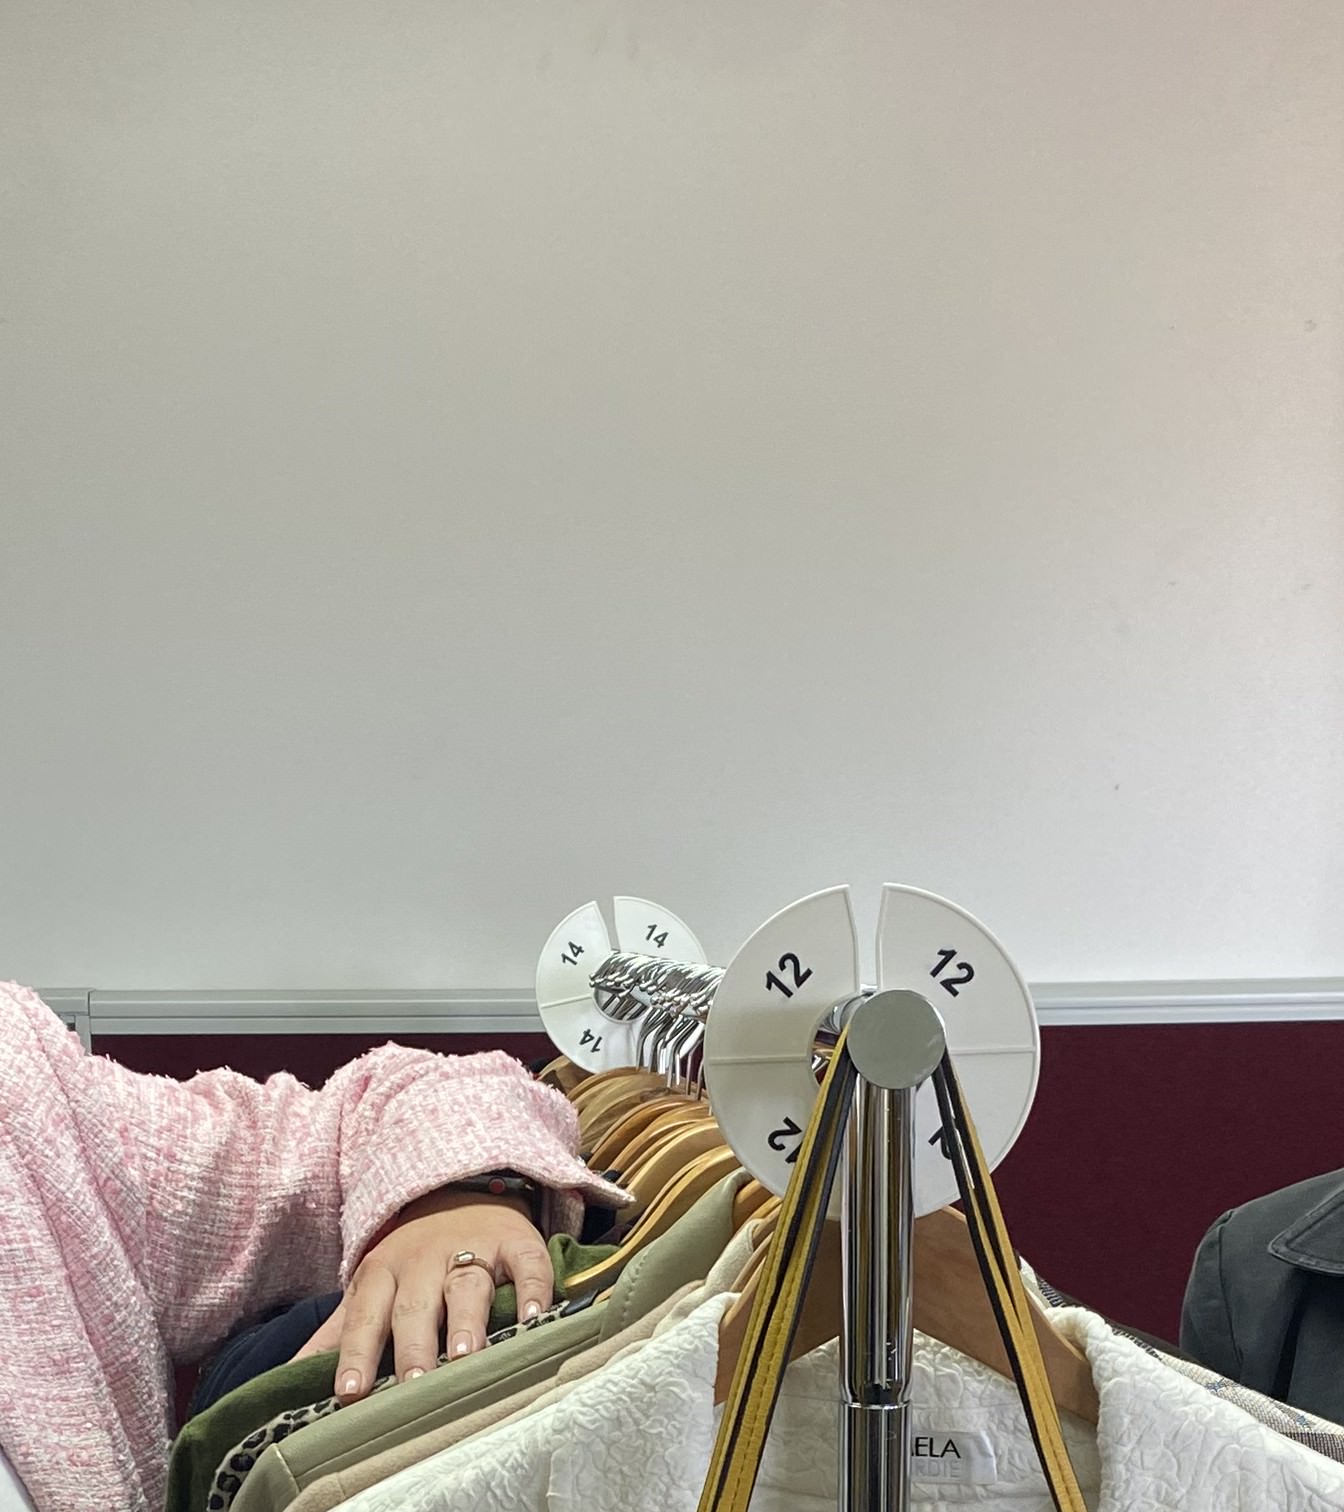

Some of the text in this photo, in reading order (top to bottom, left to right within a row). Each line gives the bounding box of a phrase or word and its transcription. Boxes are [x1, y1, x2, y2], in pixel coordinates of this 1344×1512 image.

[644, 924, 669, 948] 14
[560, 941, 585, 966] 14
[766, 952, 813, 998] 12
[929, 949, 975, 998] 12
[579, 1028, 603, 1054] 14
[911, 1436, 961, 1459] ELA
